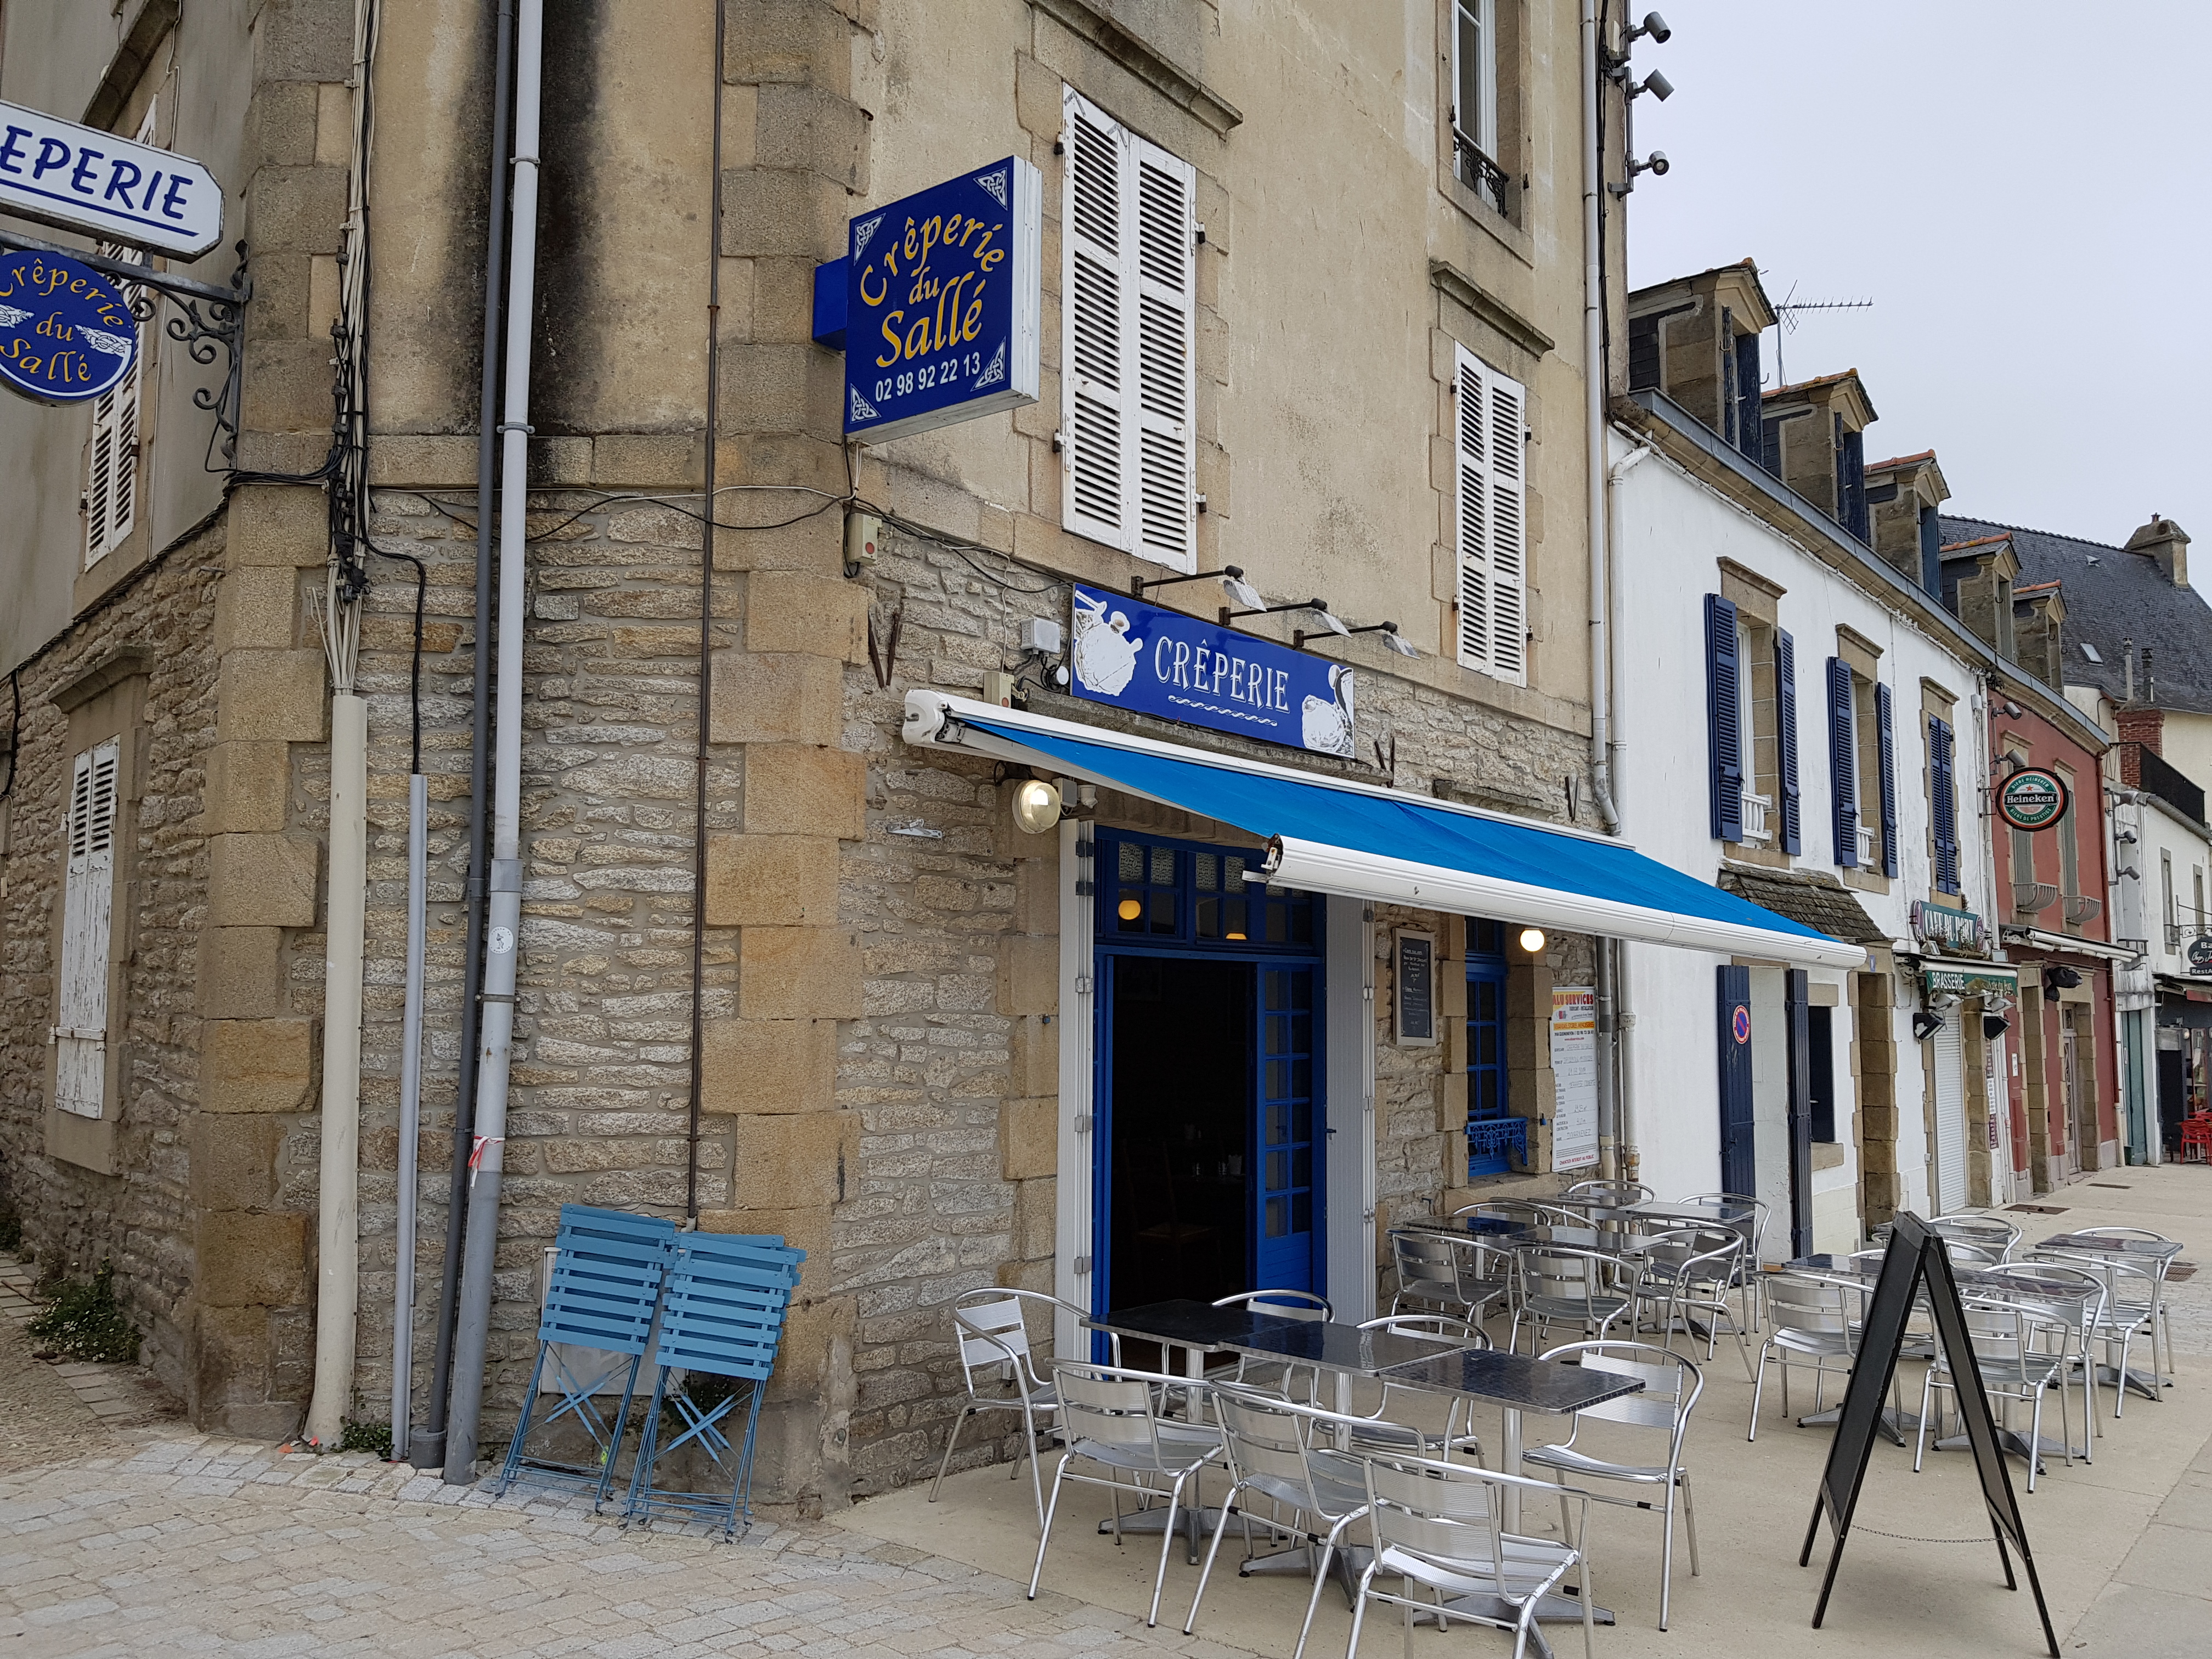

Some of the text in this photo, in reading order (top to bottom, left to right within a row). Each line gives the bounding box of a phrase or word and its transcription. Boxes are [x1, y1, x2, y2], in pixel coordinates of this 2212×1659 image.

[860, 213, 1005, 306] Crêperie
[908, 266, 940, 306] du
[36, 311, 74, 341] du
[876, 271, 986, 368] Sallé
[0, 338, 92, 383] Sallé
[875, 352, 980, 402] 02 98 92 22 13
[1155, 635, 1291, 714] CRÊPERIE
[2025, 777, 2050, 787] HEINEKEN
[2007, 794, 2054, 803] Heineken
[2030, 807, 2052, 822] PRESTIGE
[1944, 913, 1954, 942] DU
[1955, 916, 1974, 944] PORT
[1932, 972, 1965, 990] BRASSERIE
[1553, 994, 1594, 1006] ALU SERVICES
